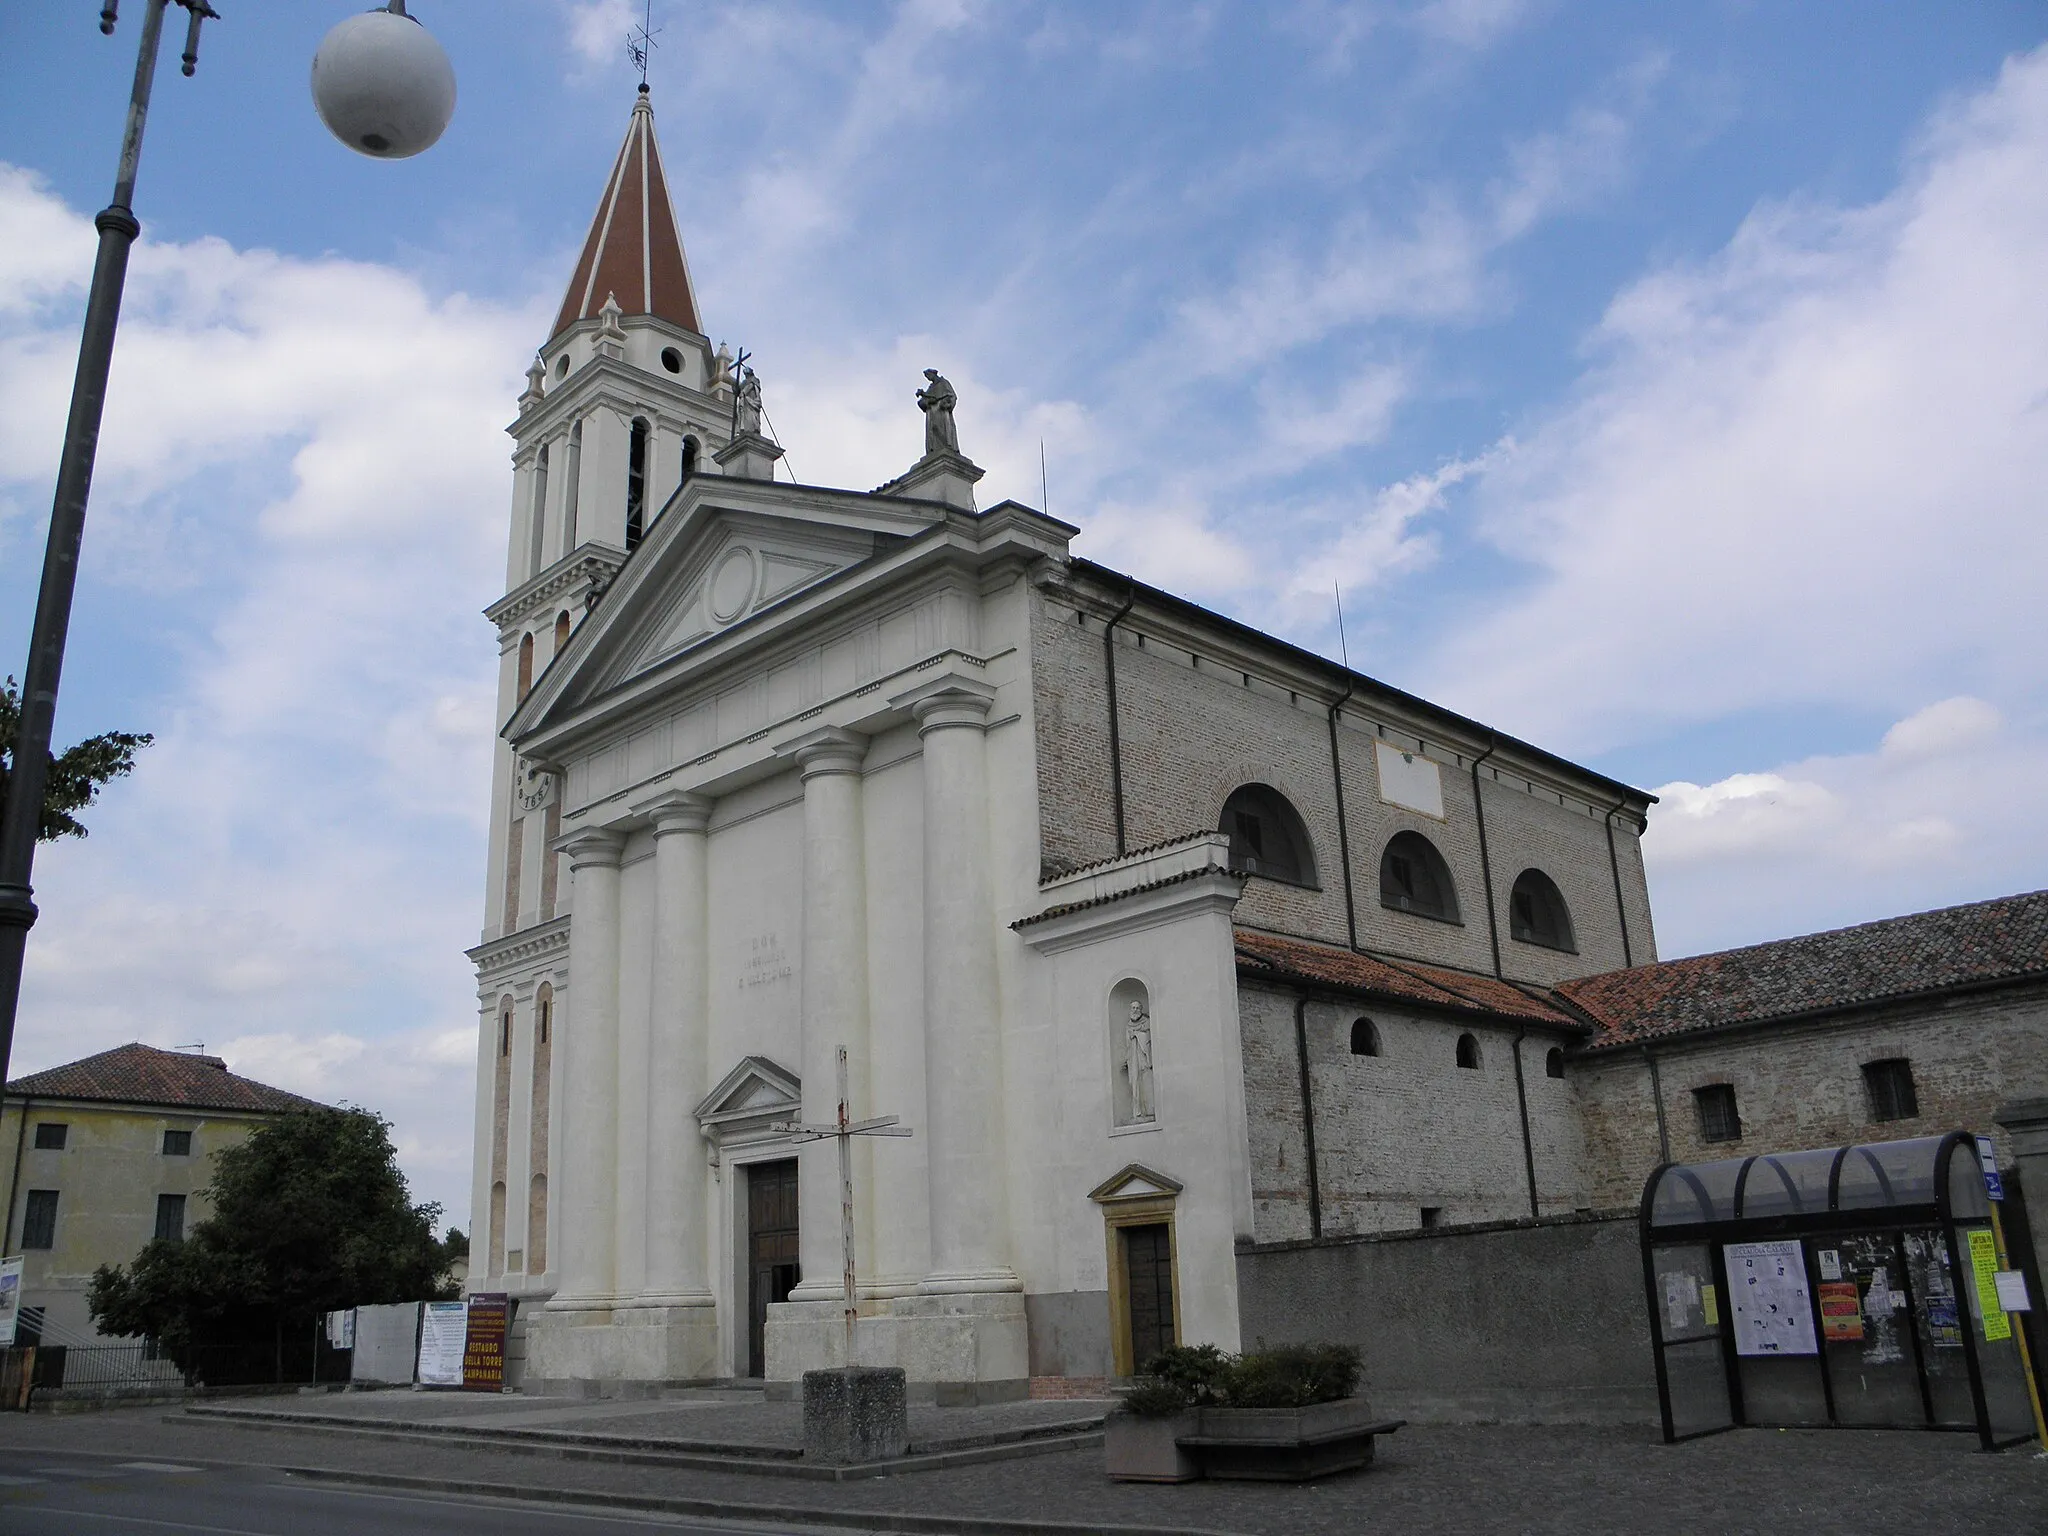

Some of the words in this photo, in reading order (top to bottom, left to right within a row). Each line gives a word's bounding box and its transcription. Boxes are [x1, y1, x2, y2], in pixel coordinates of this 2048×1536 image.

[518, 776, 522, 786] 9
[519, 788, 523, 799] 8
[525, 796, 530, 808] 7
[531, 796, 536, 807] 6
[469, 1342, 498, 1353] RESTAURO
[464, 1355, 481, 1366] DELLA
[482, 1355, 502, 1367] TORRE
[464, 1368, 502, 1380] CAMPANARIA
